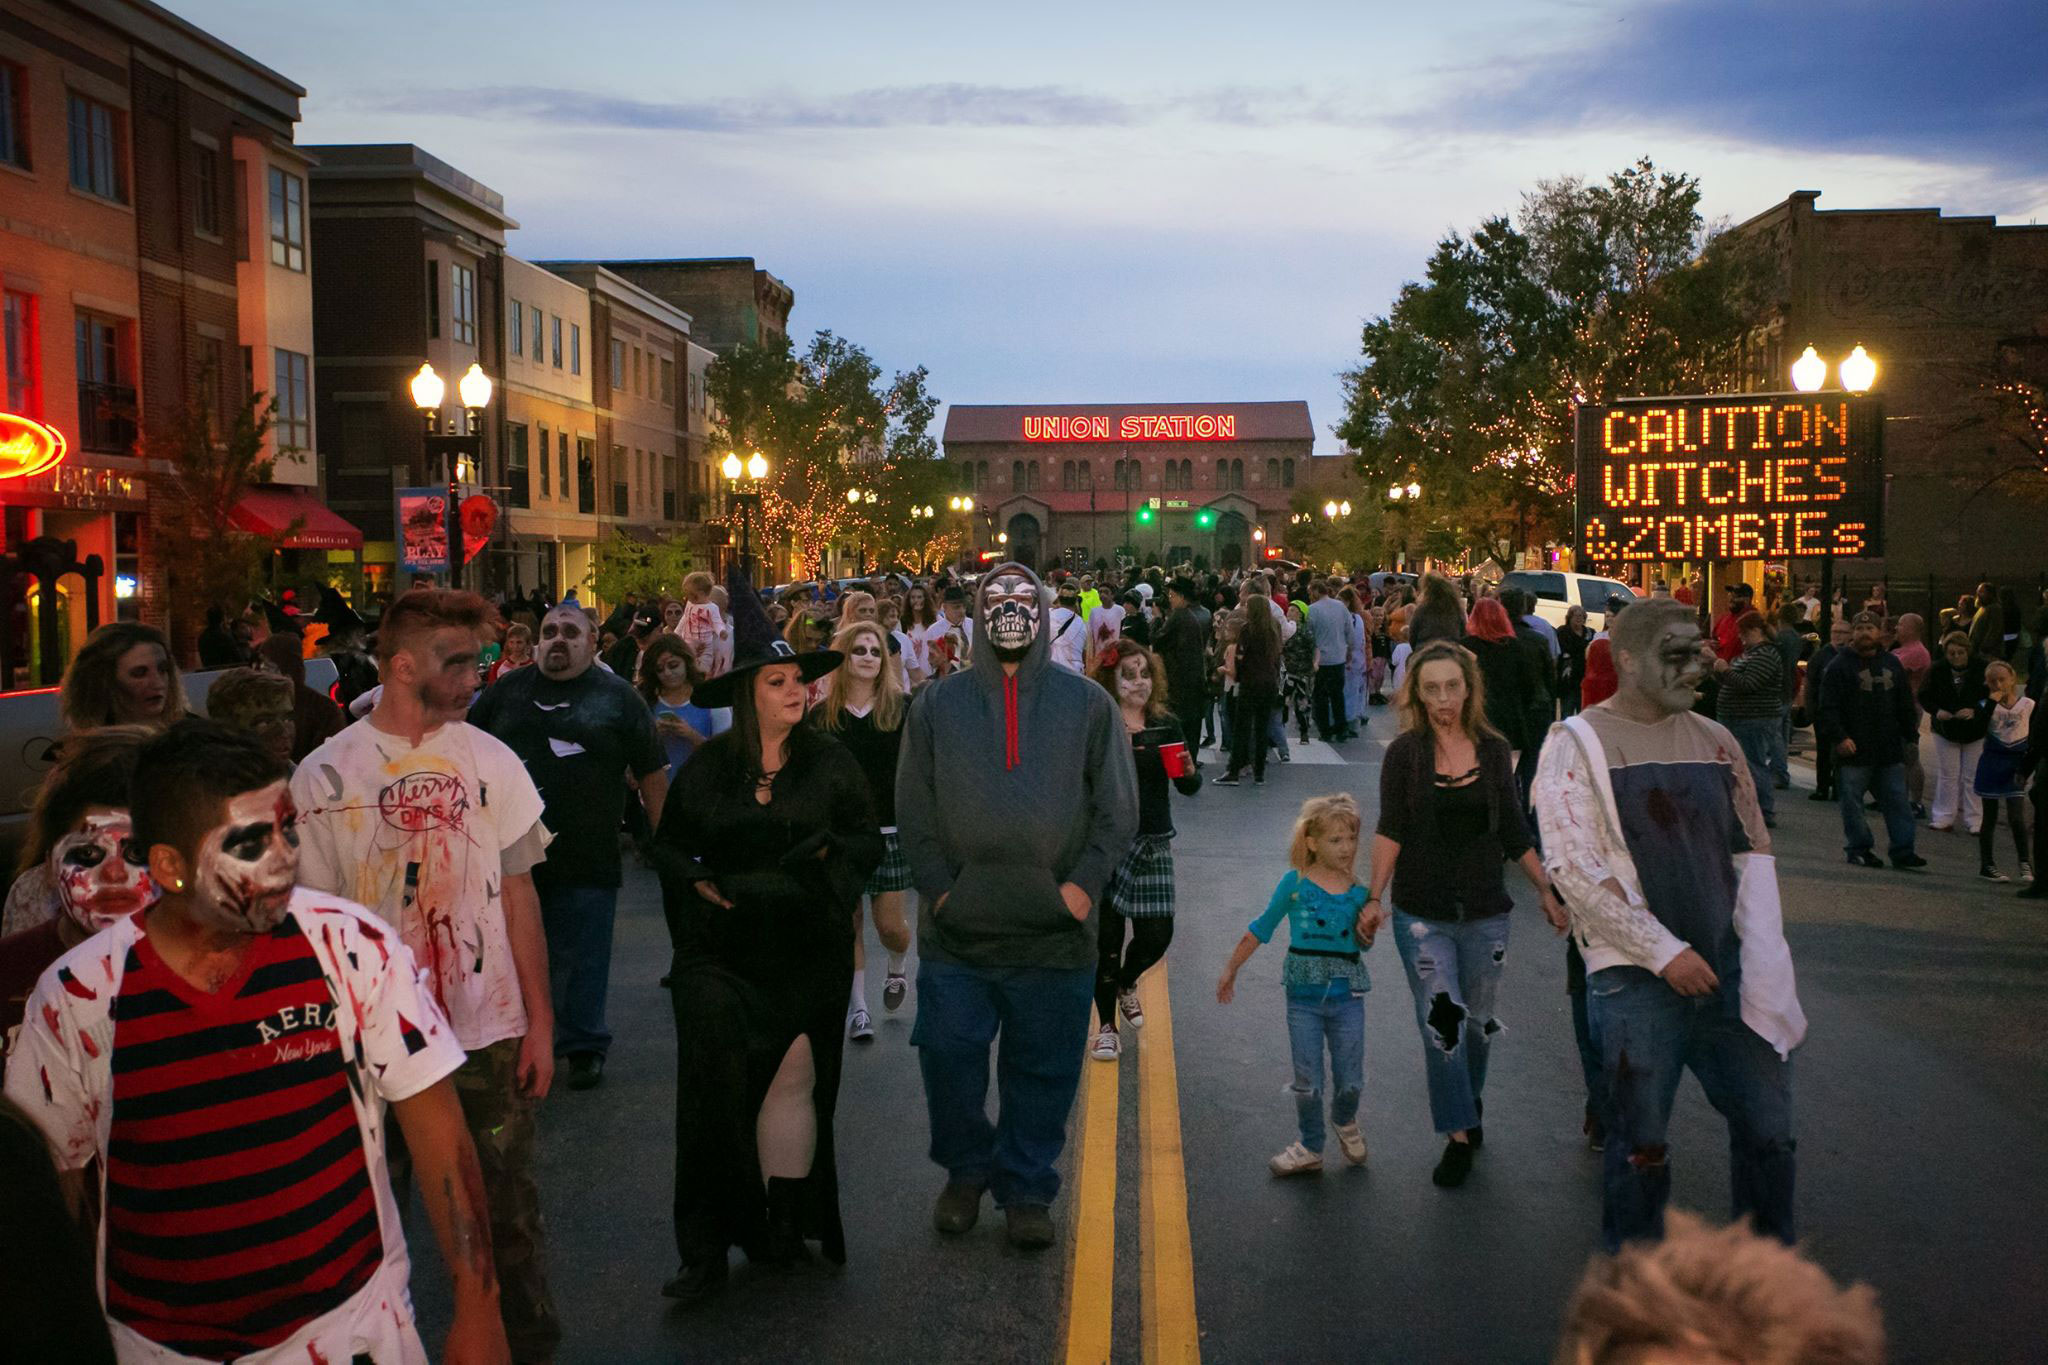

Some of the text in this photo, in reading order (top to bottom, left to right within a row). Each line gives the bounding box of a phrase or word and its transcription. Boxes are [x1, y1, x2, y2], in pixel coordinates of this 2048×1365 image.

[1024, 415, 1235, 439] UNION STATION
[1604, 403, 1847, 454] CAUTION
[1604, 457, 1847, 507] WITCHES
[405, 546, 445, 559] PLAY
[379, 777, 461, 816] Cherry
[273, 1037, 332, 1063] New York
